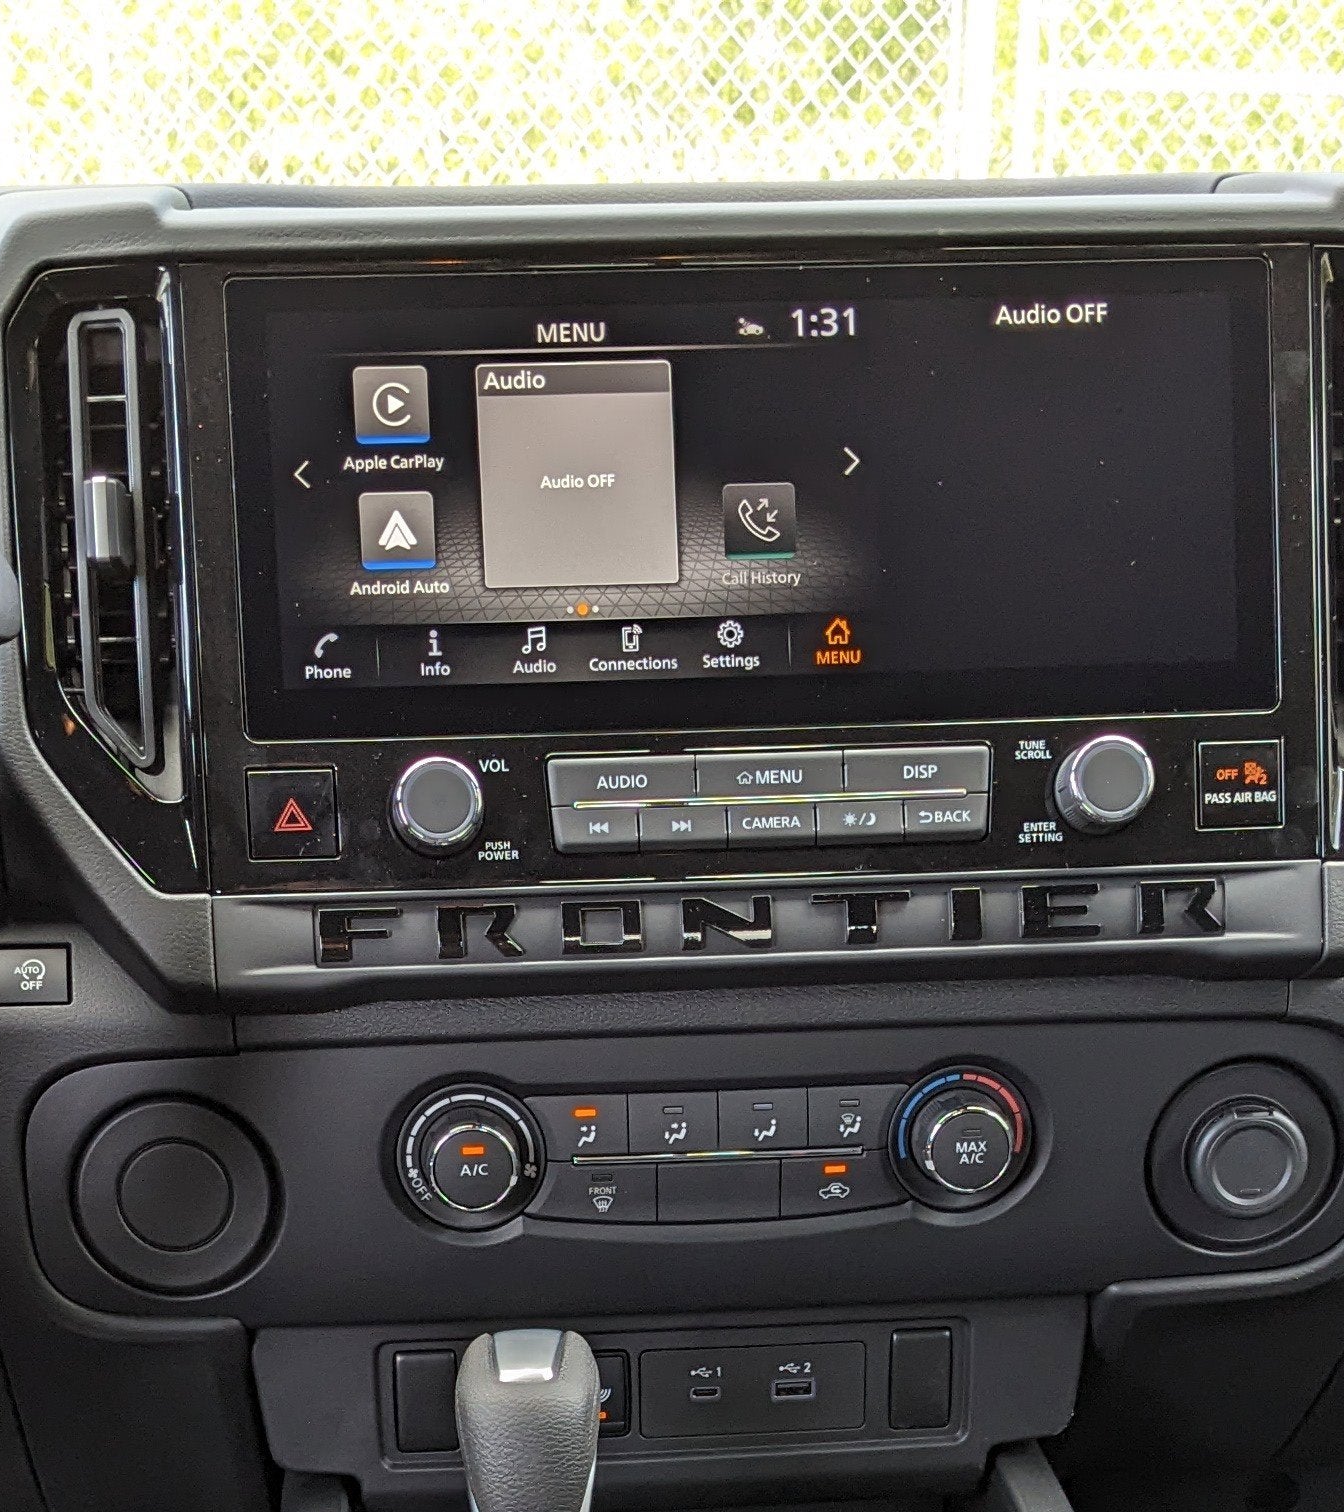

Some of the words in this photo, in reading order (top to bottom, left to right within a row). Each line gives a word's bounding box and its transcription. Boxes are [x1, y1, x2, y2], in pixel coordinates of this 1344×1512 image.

[791, 307, 856, 338] 1:31
[994, 304, 1060, 326] Audio
[1065, 303, 1108, 323] OFF
[536, 322, 606, 344] MENU
[483, 370, 546, 391] Audio
[343, 454, 387, 473] Apple
[390, 453, 445, 472] CarPlay
[540, 473, 584, 489] Audio
[587, 473, 615, 488] OFF
[721, 569, 747, 585] Call
[750, 568, 801, 588] History
[350, 578, 411, 595] Android
[415, 578, 449, 595] Auto
[589, 655, 677, 671] Connections
[702, 653, 760, 672] Settings
[815, 649, 861, 665] MENU
[304, 664, 352, 680] Phone
[420, 661, 450, 677] Info
[513, 659, 556, 675] Audio
[1018, 740, 1046, 751] TUNE
[1015, 748, 1052, 761] SCROLL
[479, 759, 510, 773] VOL
[903, 764, 938, 781] DISP
[596, 774, 649, 790] AUDIO
[755, 769, 804, 786] MENU
[1216, 769, 1238, 780] OFF
[1204, 793, 1231, 804] PASS
[1233, 792, 1253, 803] AIR
[1254, 790, 1276, 802] BAG
[742, 815, 802, 831] CAMERA
[934, 809, 971, 825] BACK
[1023, 821, 1056, 833] ENTER
[1018, 831, 1063, 844] SETTING
[485, 841, 512, 851] PUSH
[478, 849, 519, 861] POWER
[315, 878, 1226, 967] FRONTIER
[14, 966, 40, 975] AUTO
[20, 980, 43, 991] OFF
[956, 1141, 987, 1153] MAX
[958, 1152, 984, 1165] A/C
[460, 1163, 489, 1177] A/C
[411, 1178, 433, 1200] OFF
[588, 1186, 617, 1195] FRONT
[716, 1367, 722, 1377] 1
[803, 1363, 812, 1373] 2
